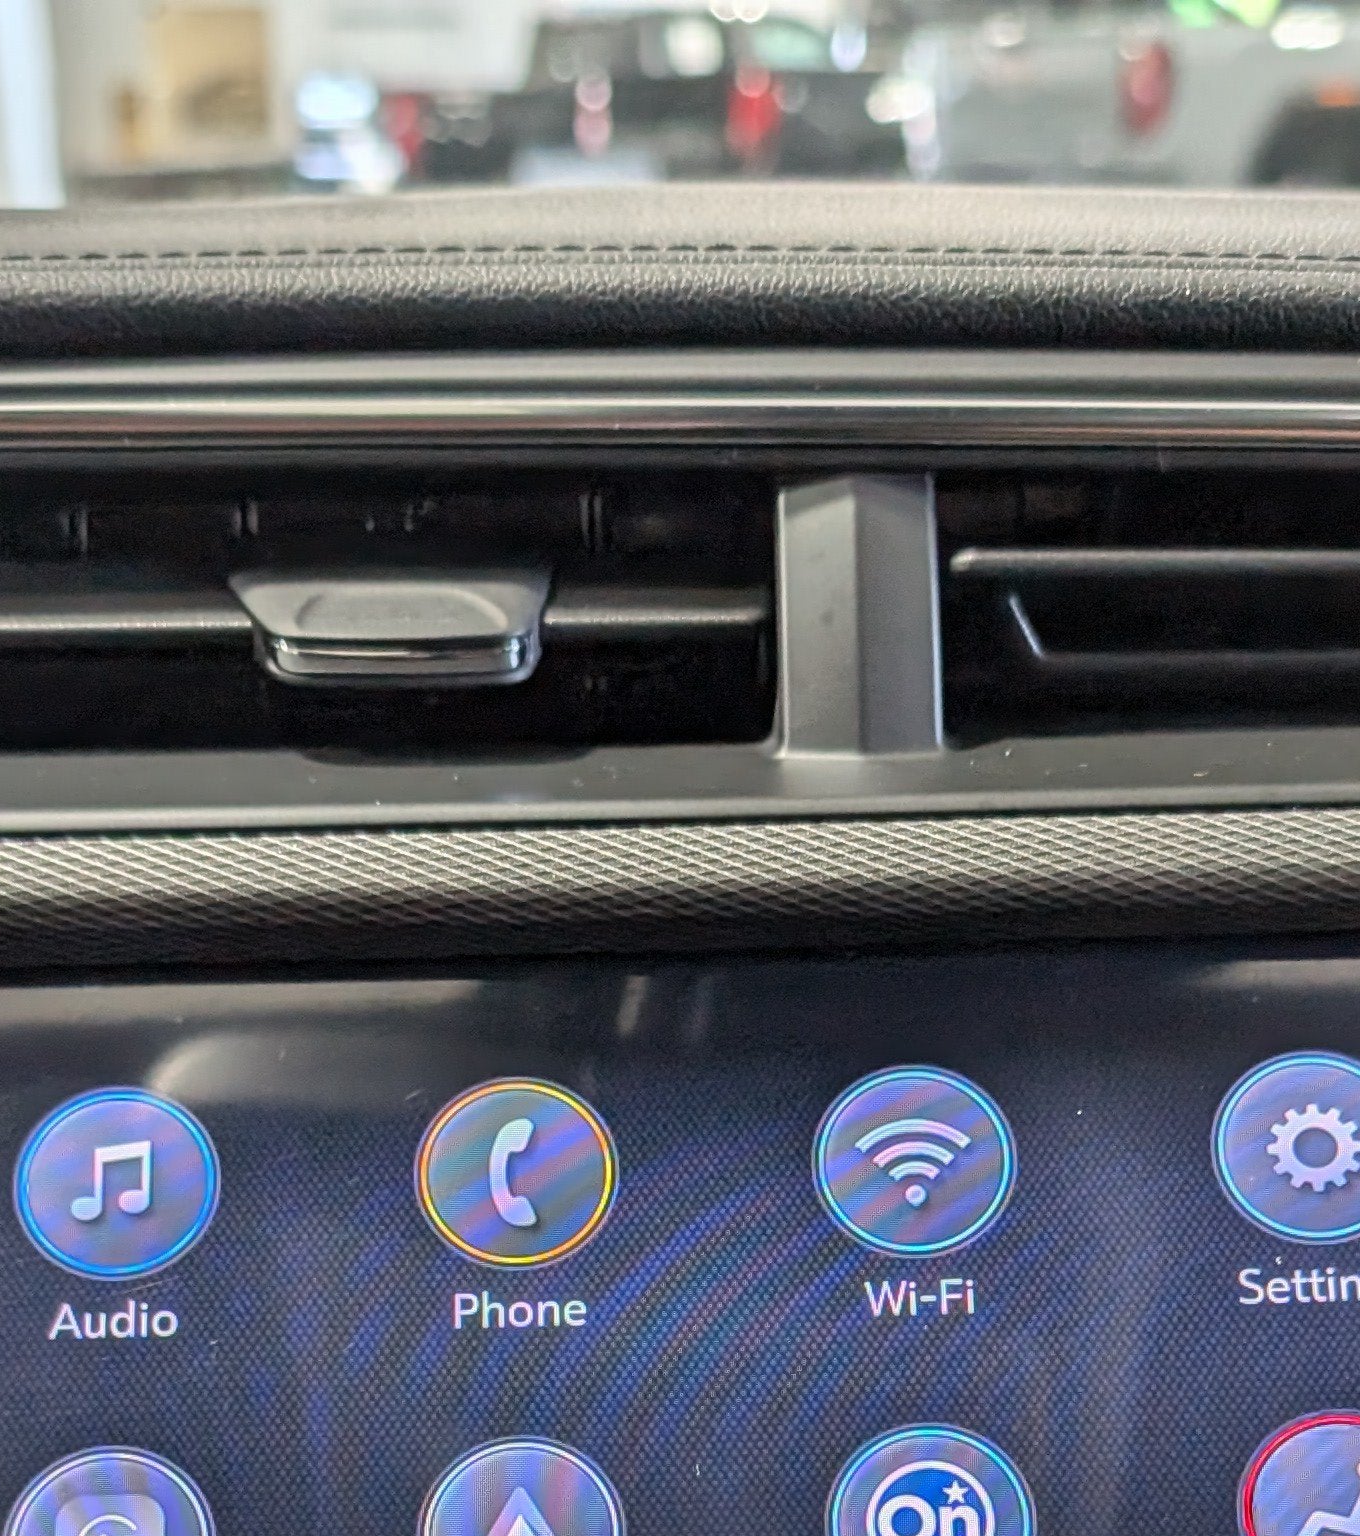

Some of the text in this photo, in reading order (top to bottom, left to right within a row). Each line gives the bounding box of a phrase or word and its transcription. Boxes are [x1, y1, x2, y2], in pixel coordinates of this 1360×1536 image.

[453, 1289, 587, 1330] Phone
[863, 1277, 976, 1318] Wi-Fi
[48, 1298, 179, 1341] Audio
